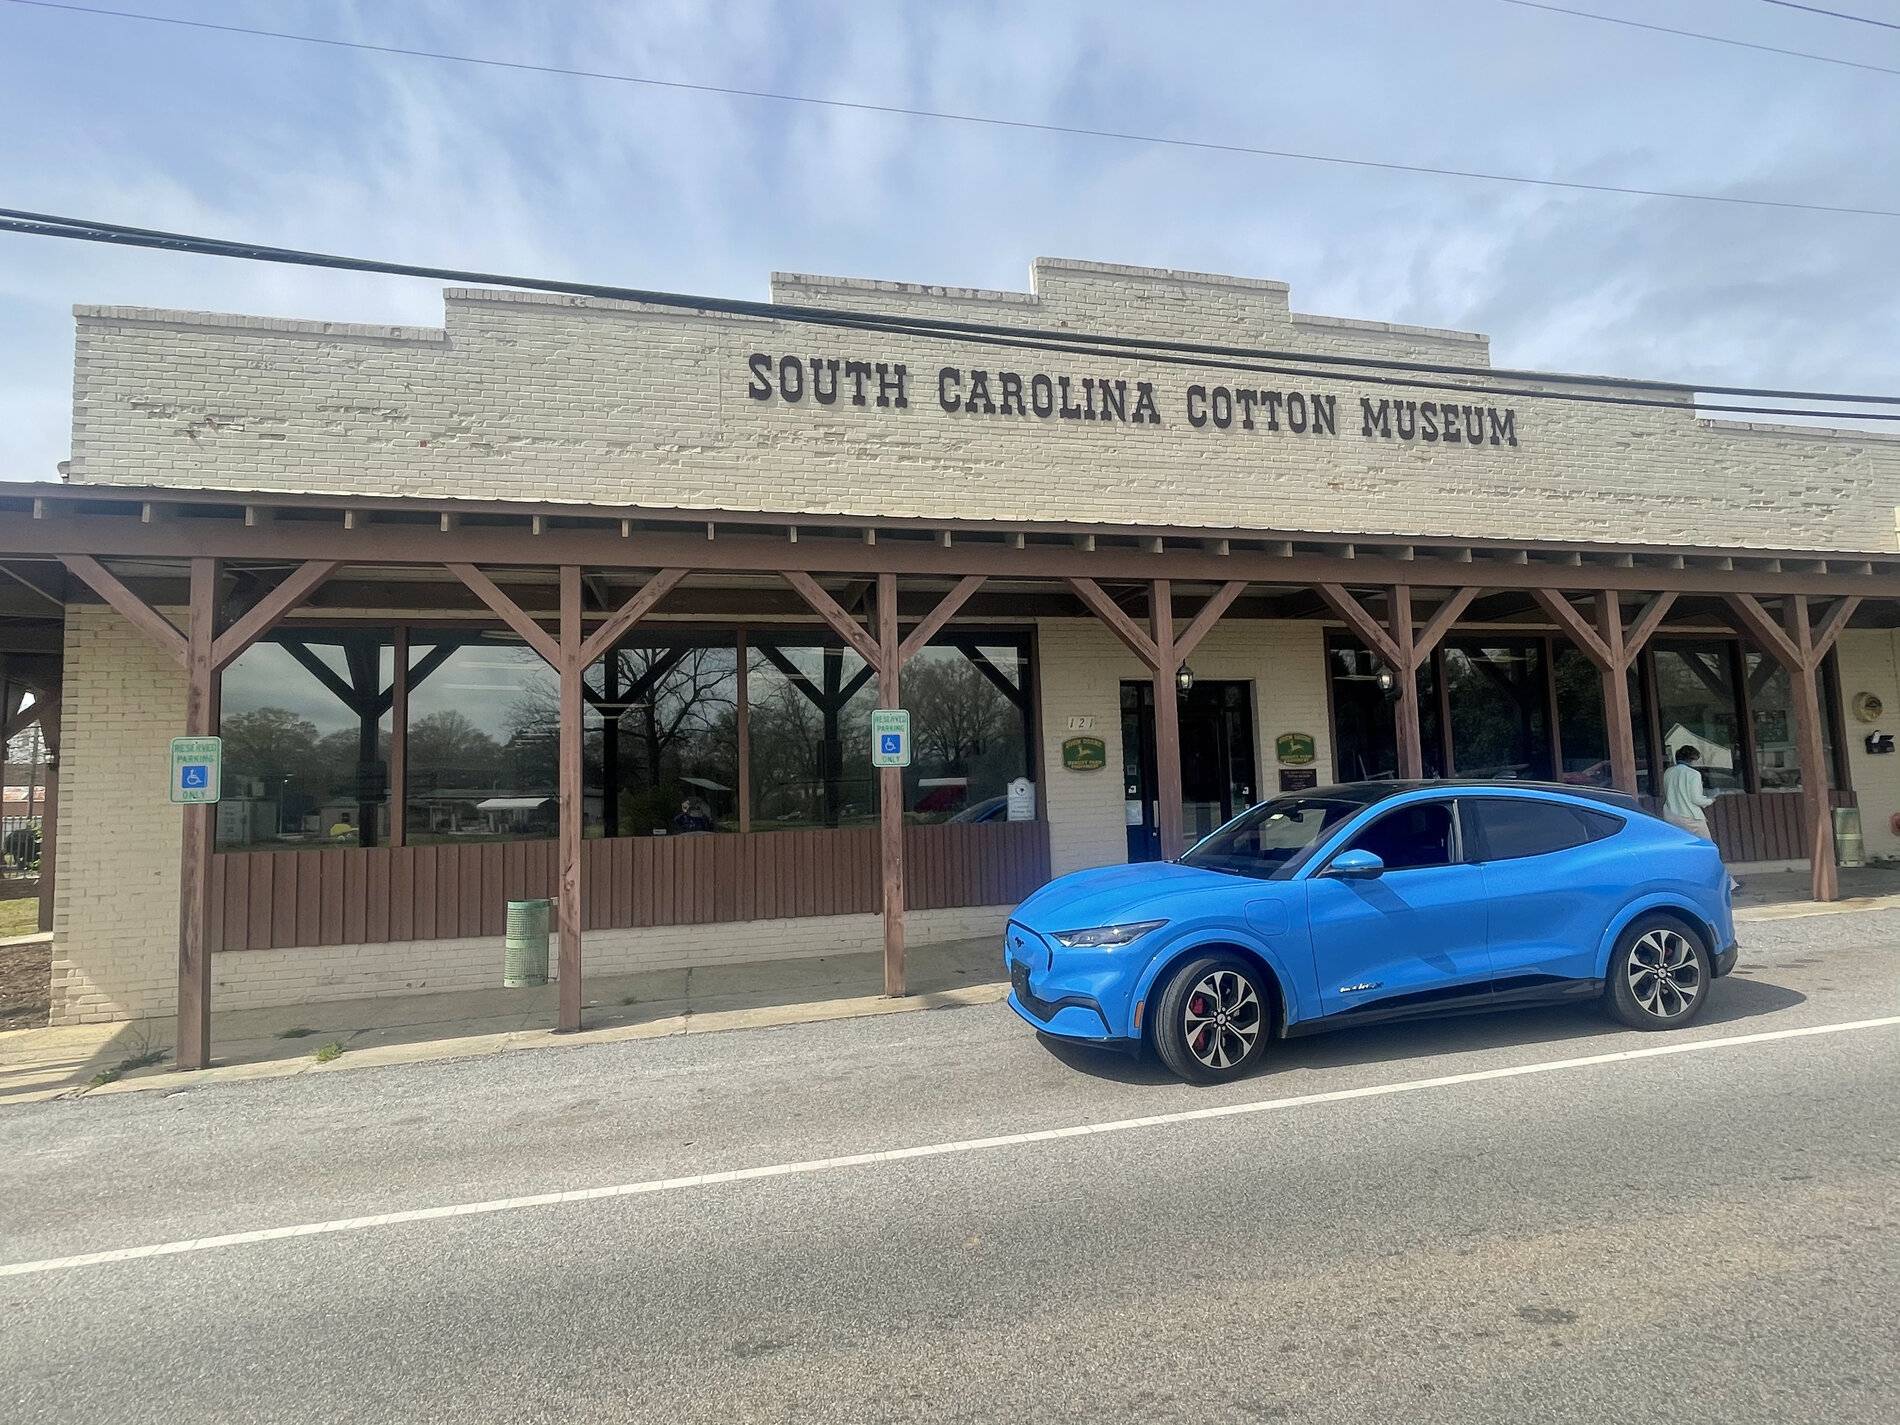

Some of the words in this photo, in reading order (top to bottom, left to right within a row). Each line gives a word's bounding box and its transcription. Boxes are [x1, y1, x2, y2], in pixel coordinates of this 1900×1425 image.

[748, 352, 908, 409] SOUTH
[938, 366, 1161, 425] CAROLINA
[1186, 384, 1337, 436] COTTON
[1360, 397, 1518, 447] MUSEUM
[875, 715, 907, 723] RESERVED
[1069, 717, 1094, 728] 121
[174, 743, 217, 752] RESERVED
[177, 754, 213, 762] PARKING
[183, 790, 205, 799] ONLY
